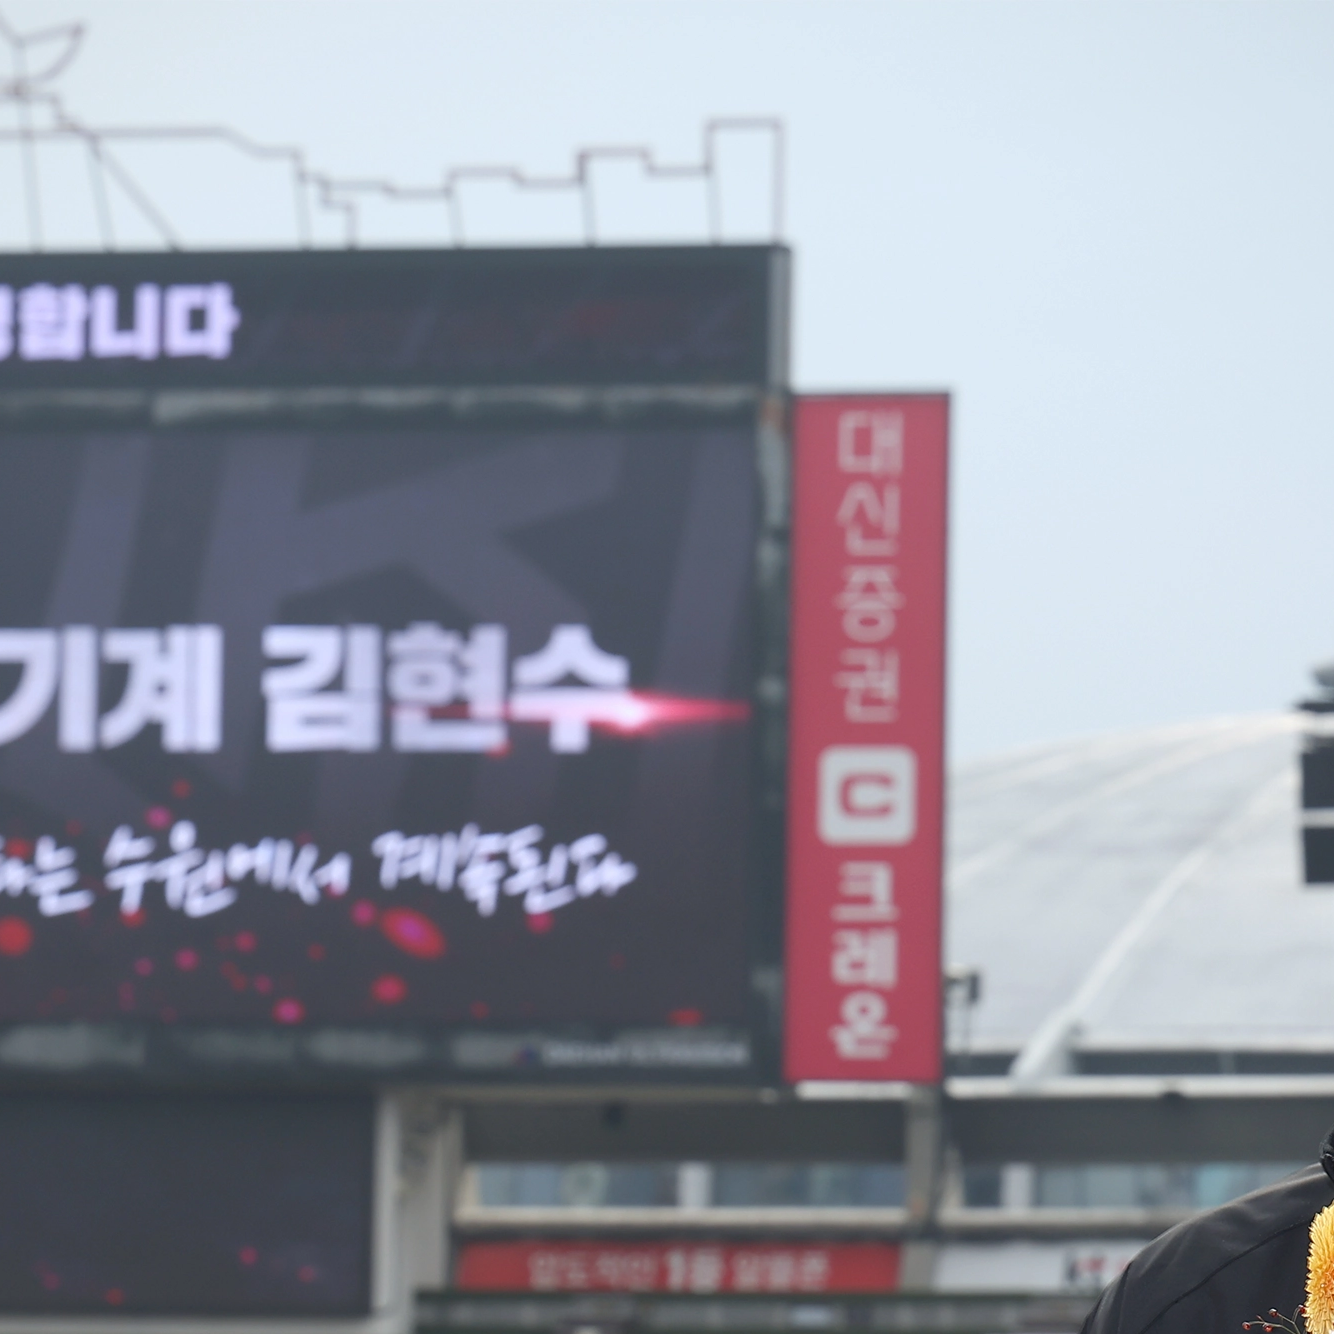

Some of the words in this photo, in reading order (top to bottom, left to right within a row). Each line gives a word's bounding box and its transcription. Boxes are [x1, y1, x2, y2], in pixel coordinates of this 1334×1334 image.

[833, 409, 906, 724] 대신증권
[262, 621, 633, 754] 김현수
[102, 819, 353, 918] 수원에서
[371, 821, 639, 918] 계속된다
[829, 860, 900, 1061] 크레온
